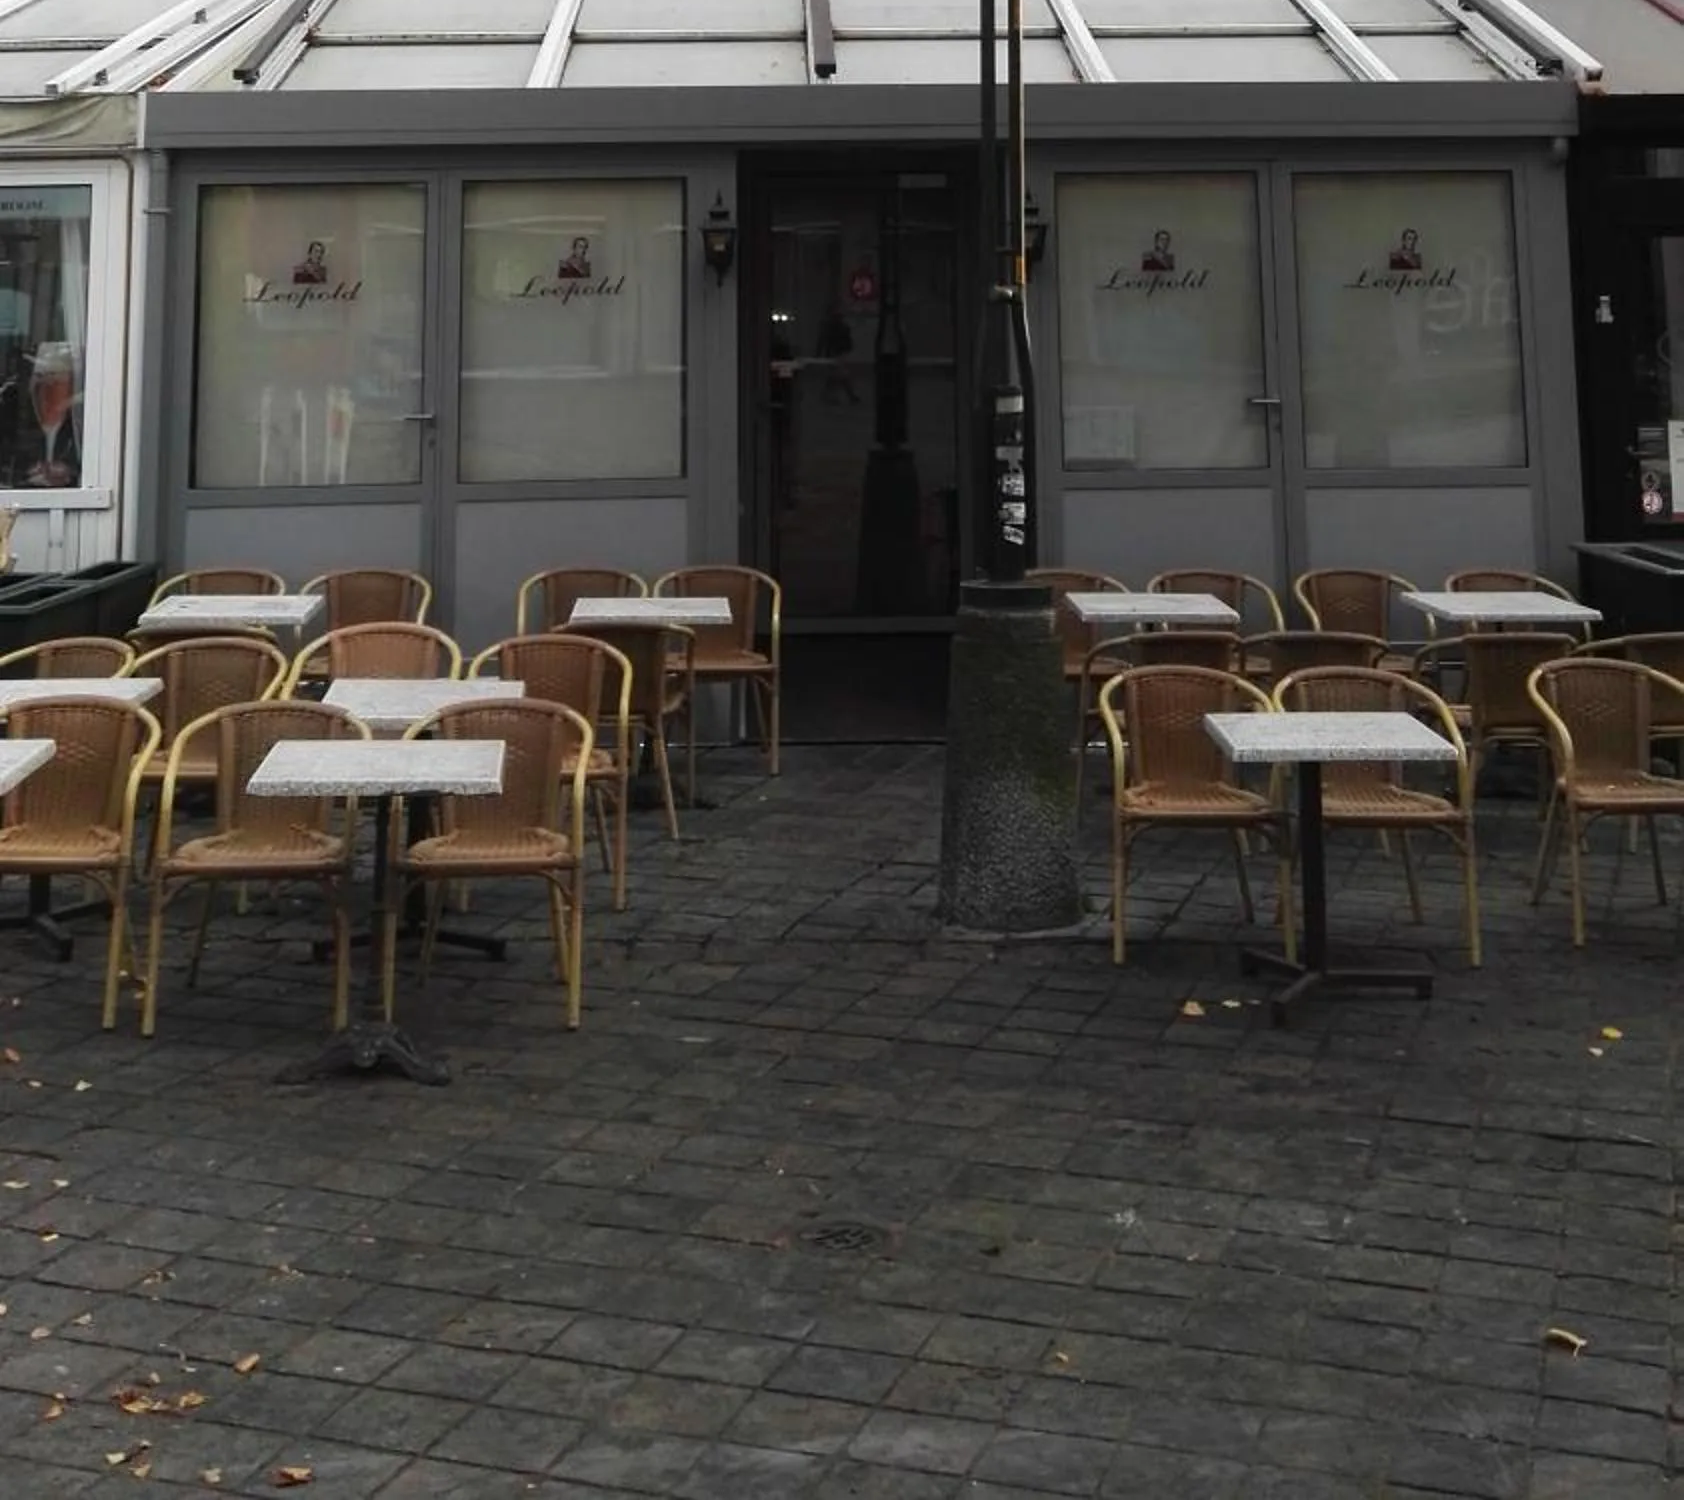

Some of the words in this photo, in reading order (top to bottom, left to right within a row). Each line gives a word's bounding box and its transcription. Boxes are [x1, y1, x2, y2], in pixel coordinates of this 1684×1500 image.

[242, 280, 362, 309] Leopold
[509, 275, 625, 306] Leopold
[1095, 268, 1211, 299] Leopold
[1342, 267, 1456, 296] Leopold
